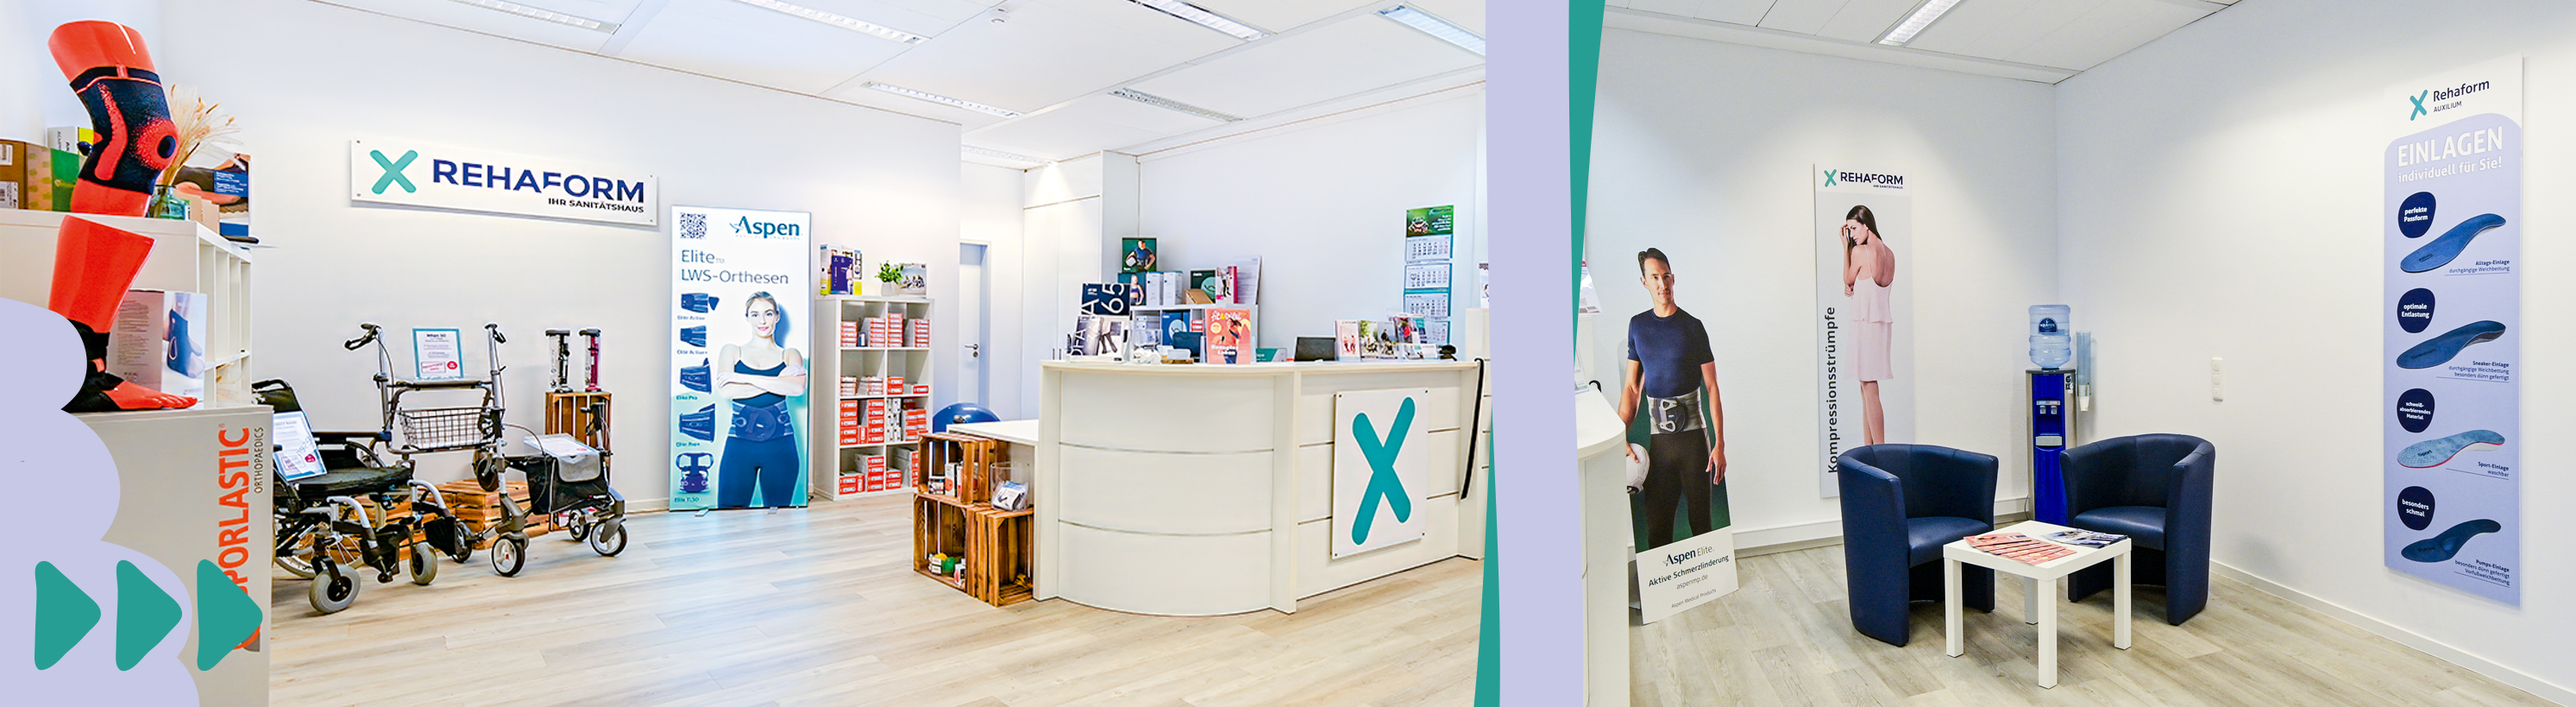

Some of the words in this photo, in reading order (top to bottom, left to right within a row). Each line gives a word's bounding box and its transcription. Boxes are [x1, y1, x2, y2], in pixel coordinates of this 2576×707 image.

[2433, 80, 2490, 102] Rehaform
[2433, 101, 2462, 112] AUXILIUM
[2397, 125, 2503, 167] EINLAGEN
[2398, 163, 2456, 183] individuell
[2459, 161, 2477, 174] für
[2479, 156, 2502, 171] Sie!
[432, 158, 644, 204] REHAFORM
[1840, 172, 1903, 185] REHAFORM
[548, 197, 567, 206] IHR
[569, 199, 644, 213] SANITÄTSHAUS
[2404, 206, 2428, 216] perfekte
[730, 216, 800, 238] Aspen
[682, 249, 715, 263] Elite
[682, 268, 789, 284] LWS-Orthesen
[1825, 306, 1840, 473] Kompressionsstrümpfe
[2399, 407, 2431, 415] absorbierendes
[254, 426, 264, 495] ORTHOPAEDICS
[2478, 461, 2510, 471] Sport-Einlage
[217, 427, 250, 596] PORLASTIC
[2402, 498, 2429, 510] besonders
[2406, 508, 2425, 517] schmal
[1662, 549, 1696, 566] Aspen
[2475, 559, 2510, 572] Pumps-Einlage
[1649, 574, 1672, 587] Aktive
[1673, 555, 1730, 578] Schmerzlinderung
[2454, 559, 2478, 570] besonders
[2490, 569, 2510, 579] gefertigt
[2465, 568, 2510, 586] Vorfußweichbettung
[1676, 574, 1708, 590] aspenmp.de
[1684, 595, 1700, 603] Medical
[1700, 589, 1717, 597] Products
